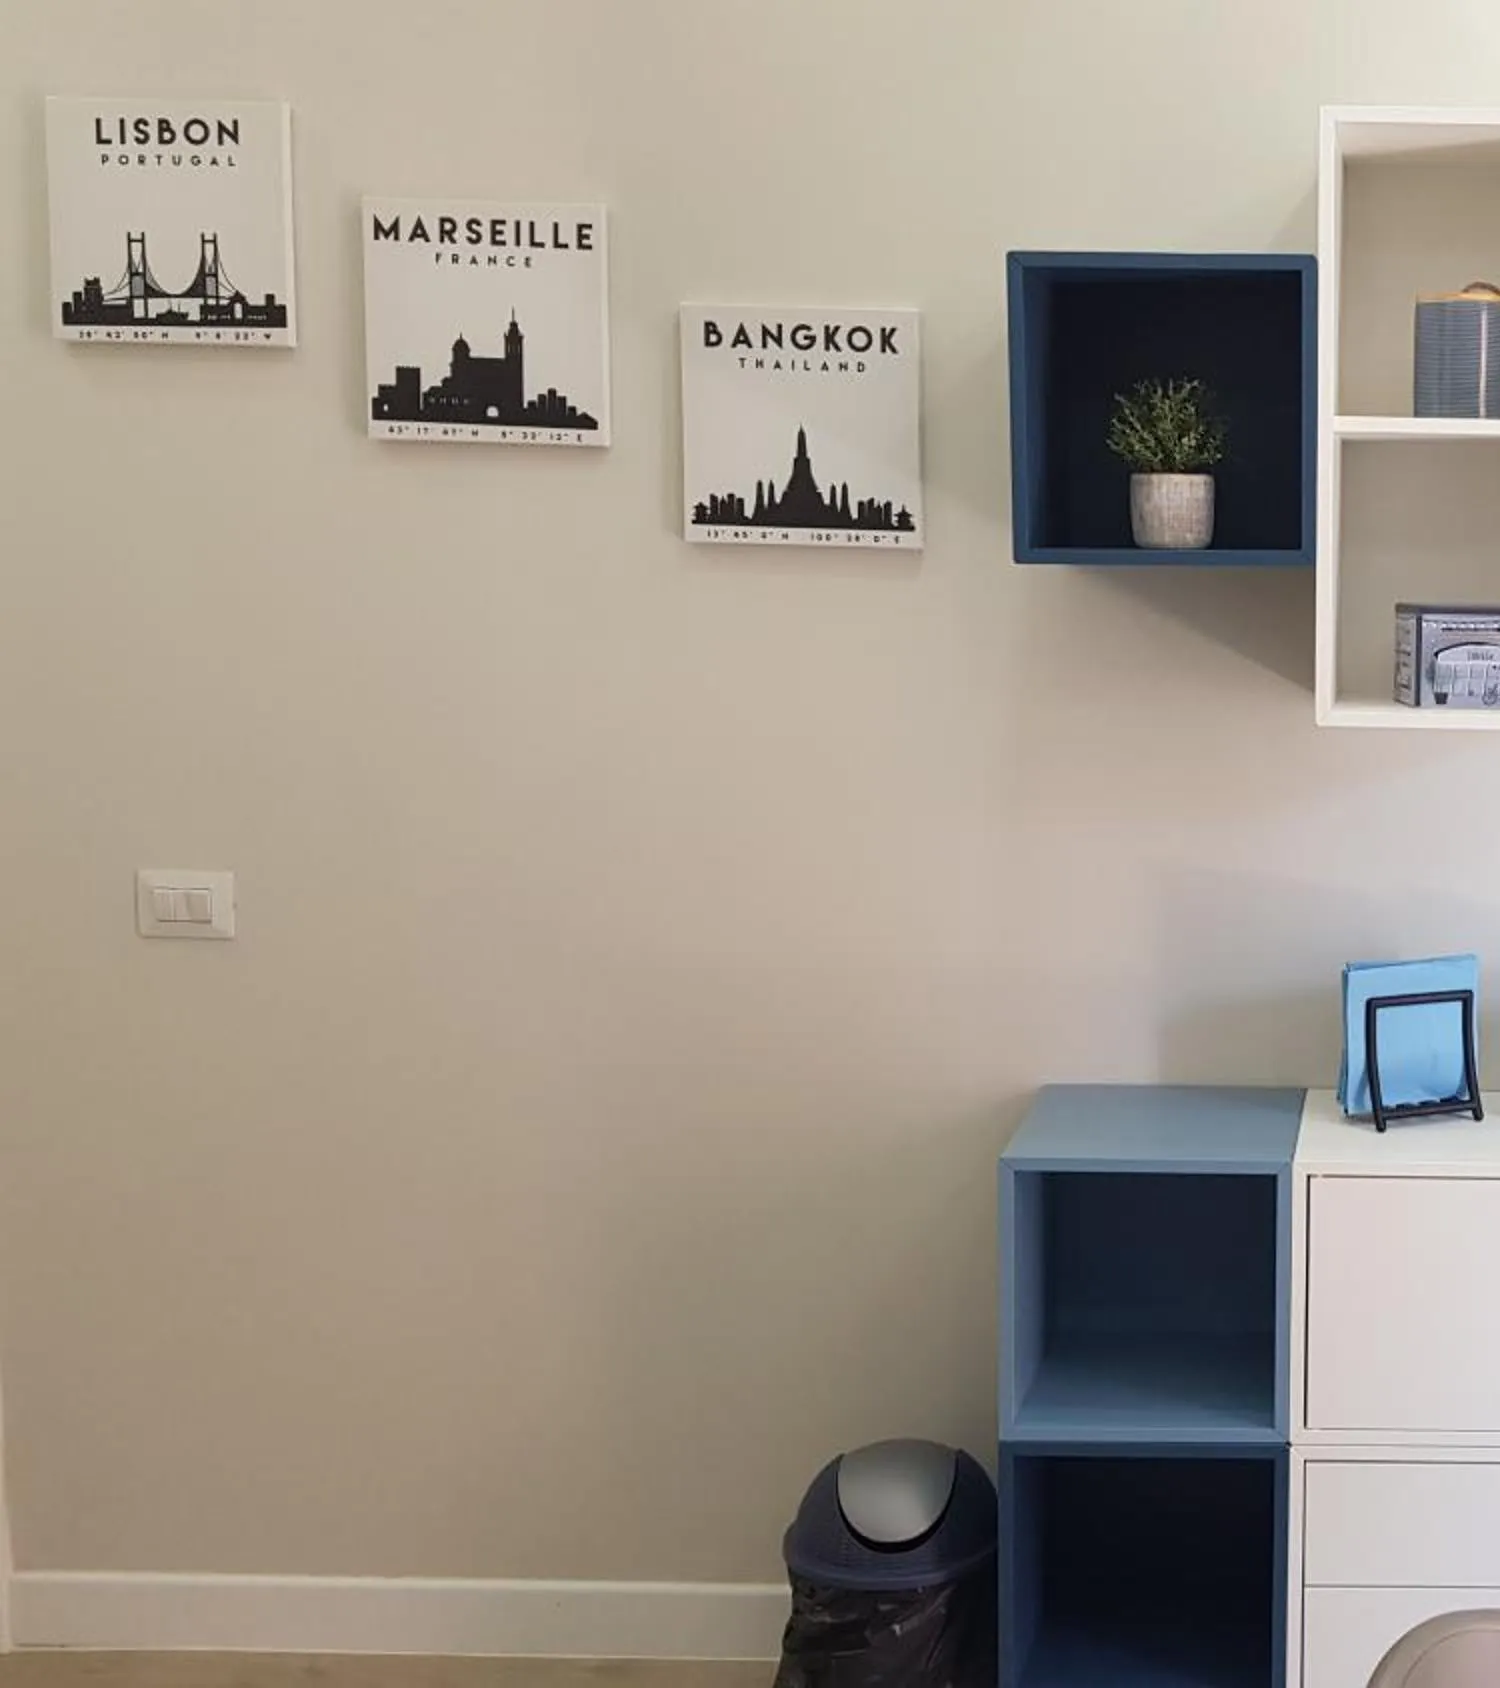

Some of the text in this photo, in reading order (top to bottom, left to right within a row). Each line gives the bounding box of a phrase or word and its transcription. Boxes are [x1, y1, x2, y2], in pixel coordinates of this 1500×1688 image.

[95, 117, 240, 146] LISBON
[101, 154, 236, 167] PORTUGAL
[373, 214, 593, 251] MARSEILLE
[435, 253, 532, 268] FRANCE
[703, 320, 899, 354] BANGKOK
[738, 357, 866, 373] THAILAND
